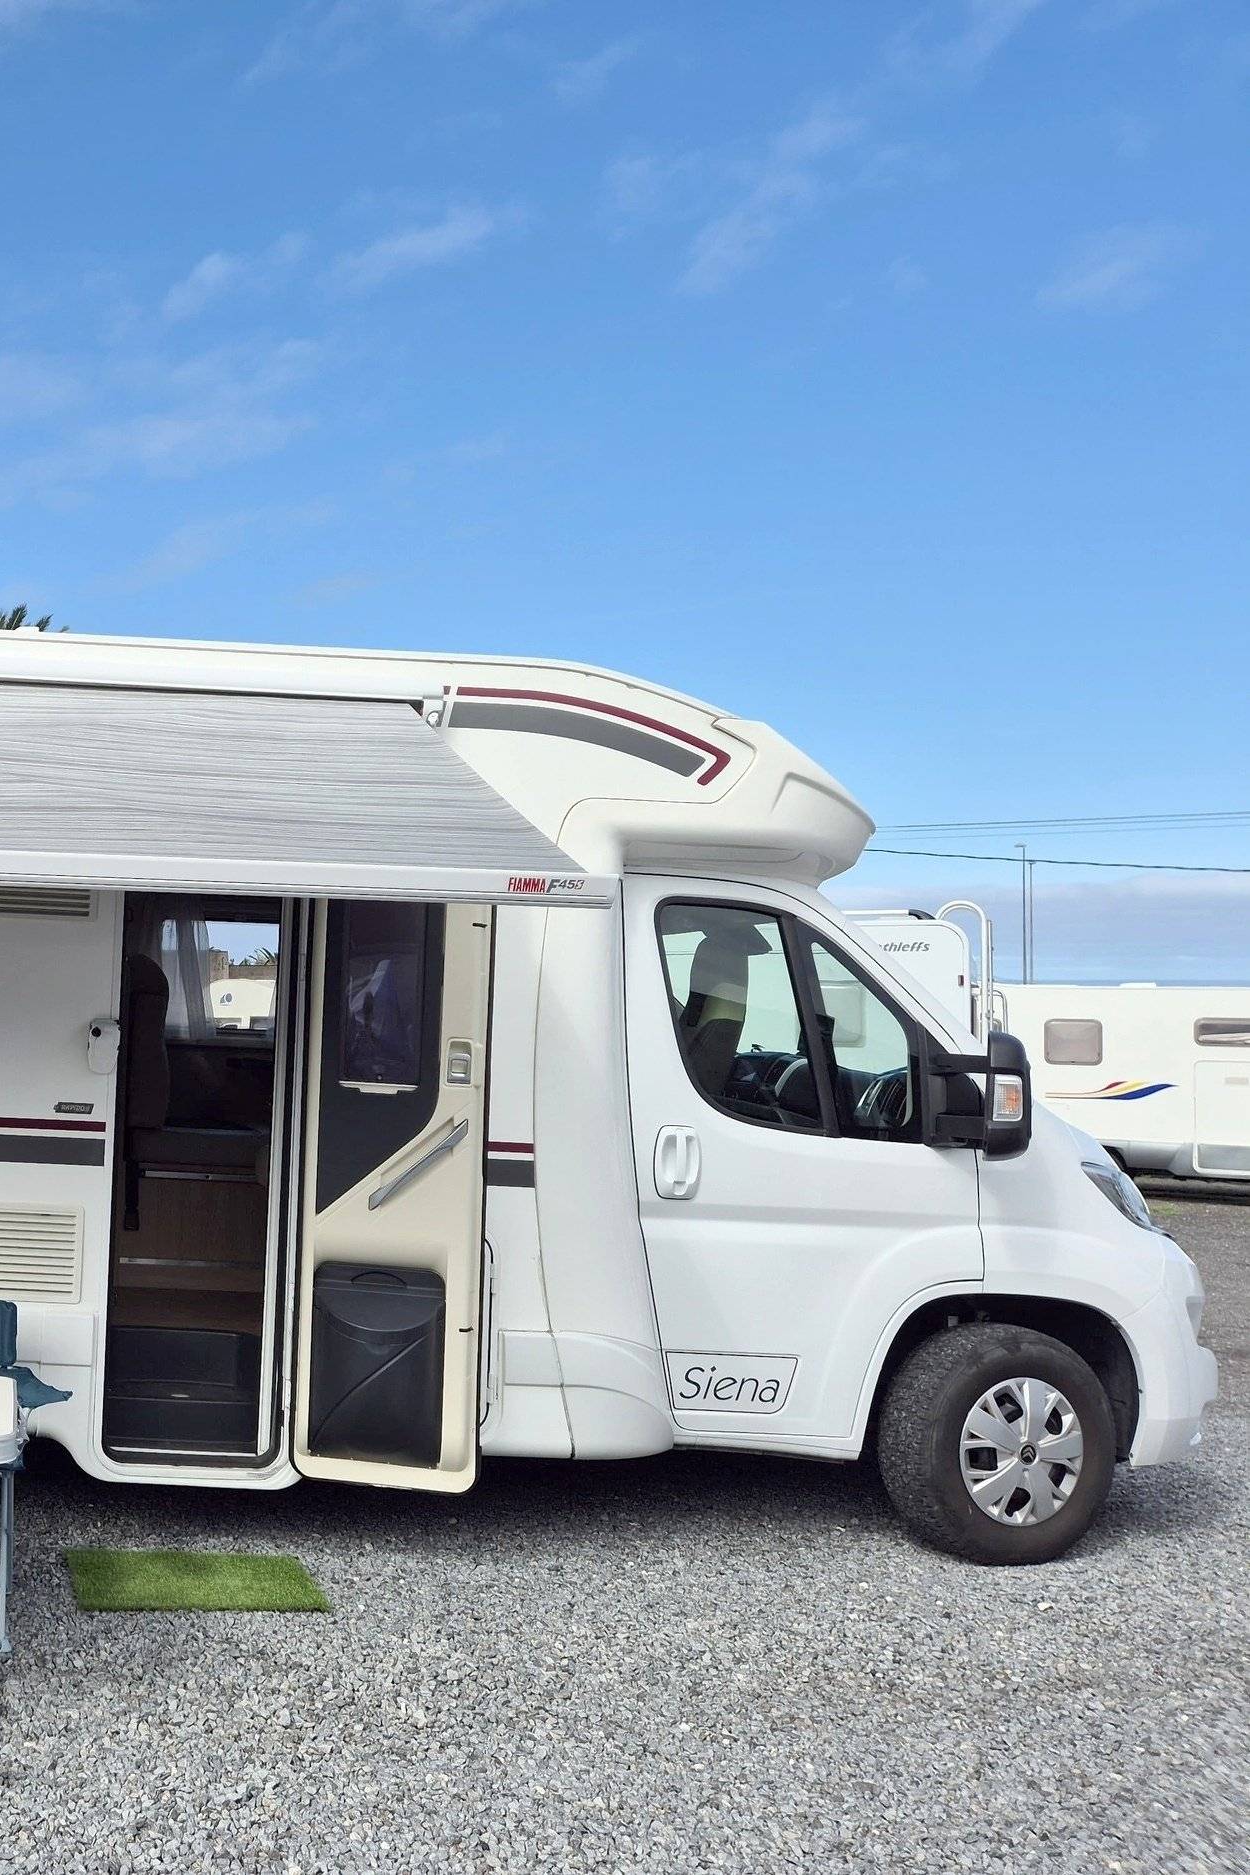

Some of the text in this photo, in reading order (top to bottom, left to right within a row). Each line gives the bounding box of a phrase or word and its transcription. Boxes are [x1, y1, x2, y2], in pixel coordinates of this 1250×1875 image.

[508, 876, 546, 893] FIAMMA
[879, 941, 930, 952] thleffs
[679, 1366, 780, 1403] Siena
